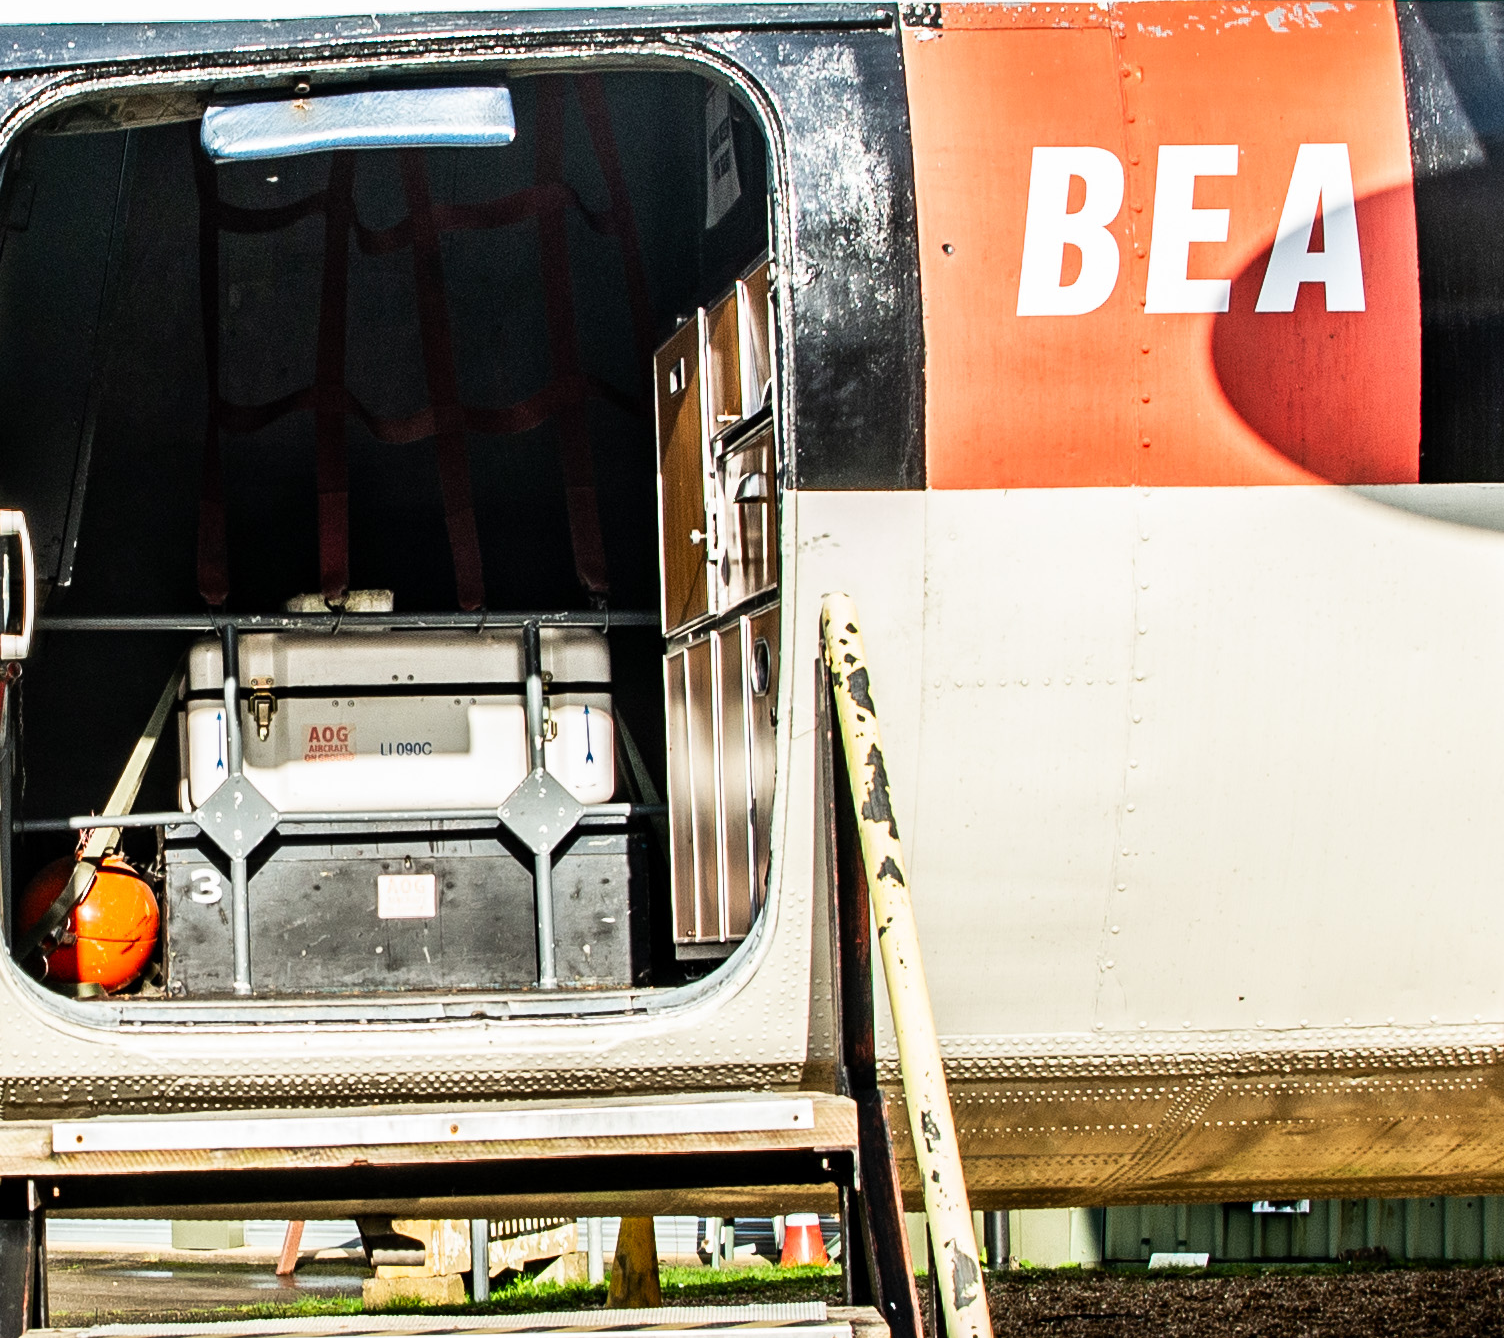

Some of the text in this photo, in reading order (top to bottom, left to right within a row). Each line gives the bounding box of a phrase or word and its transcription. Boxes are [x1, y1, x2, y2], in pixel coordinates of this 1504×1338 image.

[1016, 143, 1366, 316] BEA
[308, 726, 349, 743] AOG
[308, 744, 349, 753] AIRCRAFT
[191, 867, 223, 904] 3
